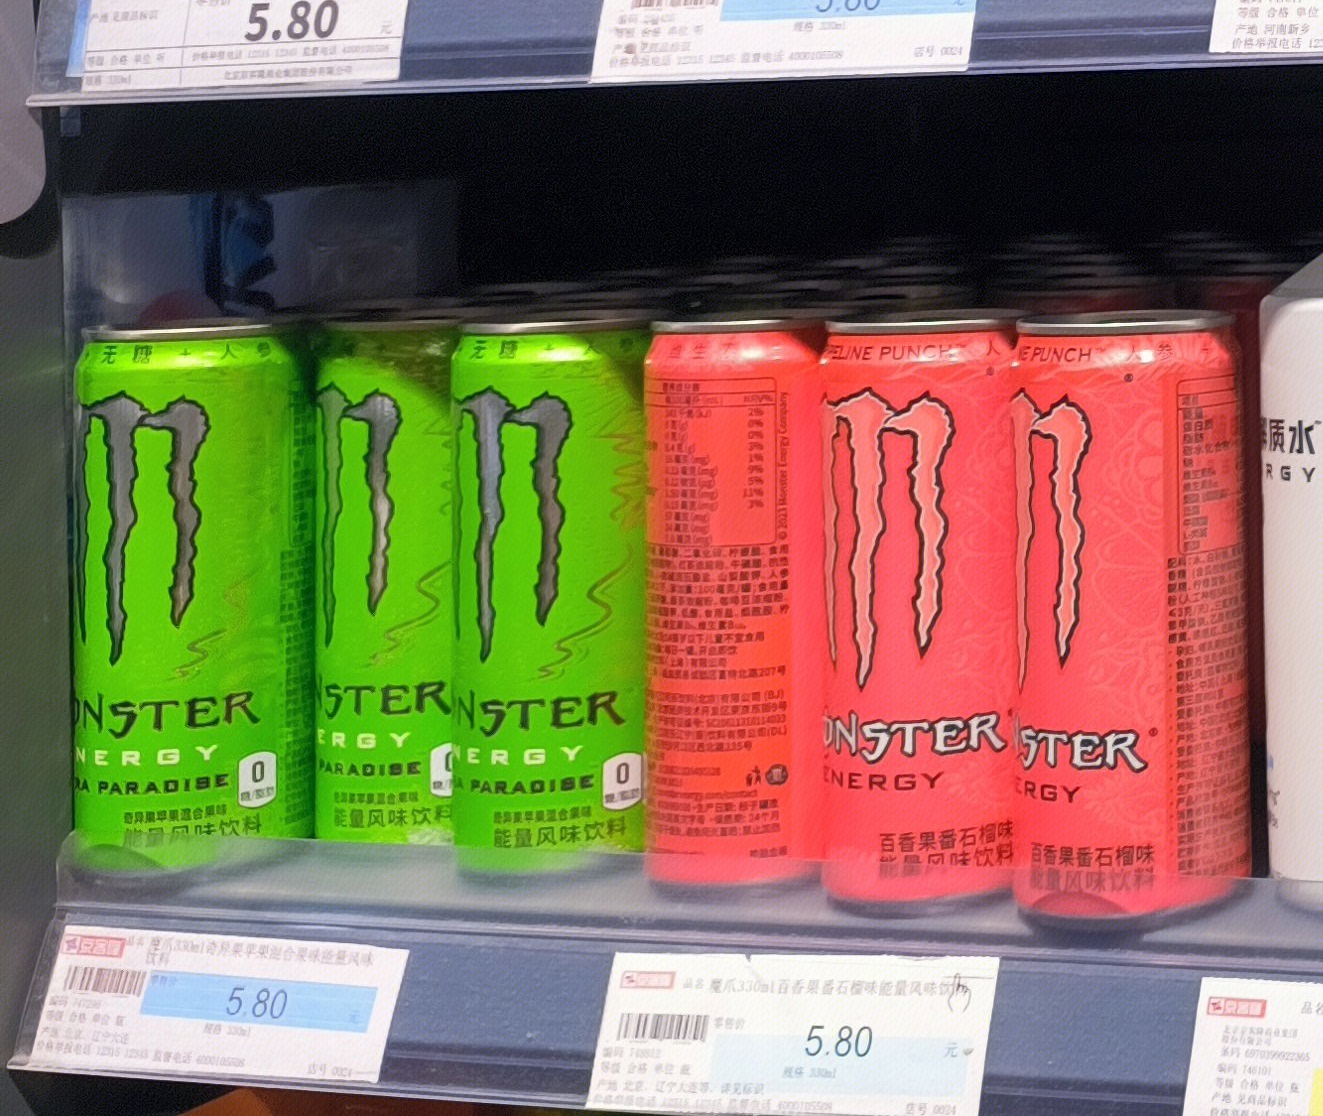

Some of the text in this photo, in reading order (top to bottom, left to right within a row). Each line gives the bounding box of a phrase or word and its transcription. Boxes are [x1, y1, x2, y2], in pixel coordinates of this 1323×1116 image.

[879, 343, 954, 362] PUNCH
[1032, 344, 1093, 363] PUNCH
[98, 772, 230, 797] PARADISE
[250, 760, 265, 784] 0
[470, 773, 595, 795] PARADISE
[615, 761, 630, 785] 0
[493, 814, 627, 849] 能量风味饮料
[878, 819, 1015, 854] 百香果番石榴味
[1029, 843, 1156, 870] 百香果番石榴味
[226, 986, 289, 1020] 5.80
[804, 1024, 874, 1058] 5.80
